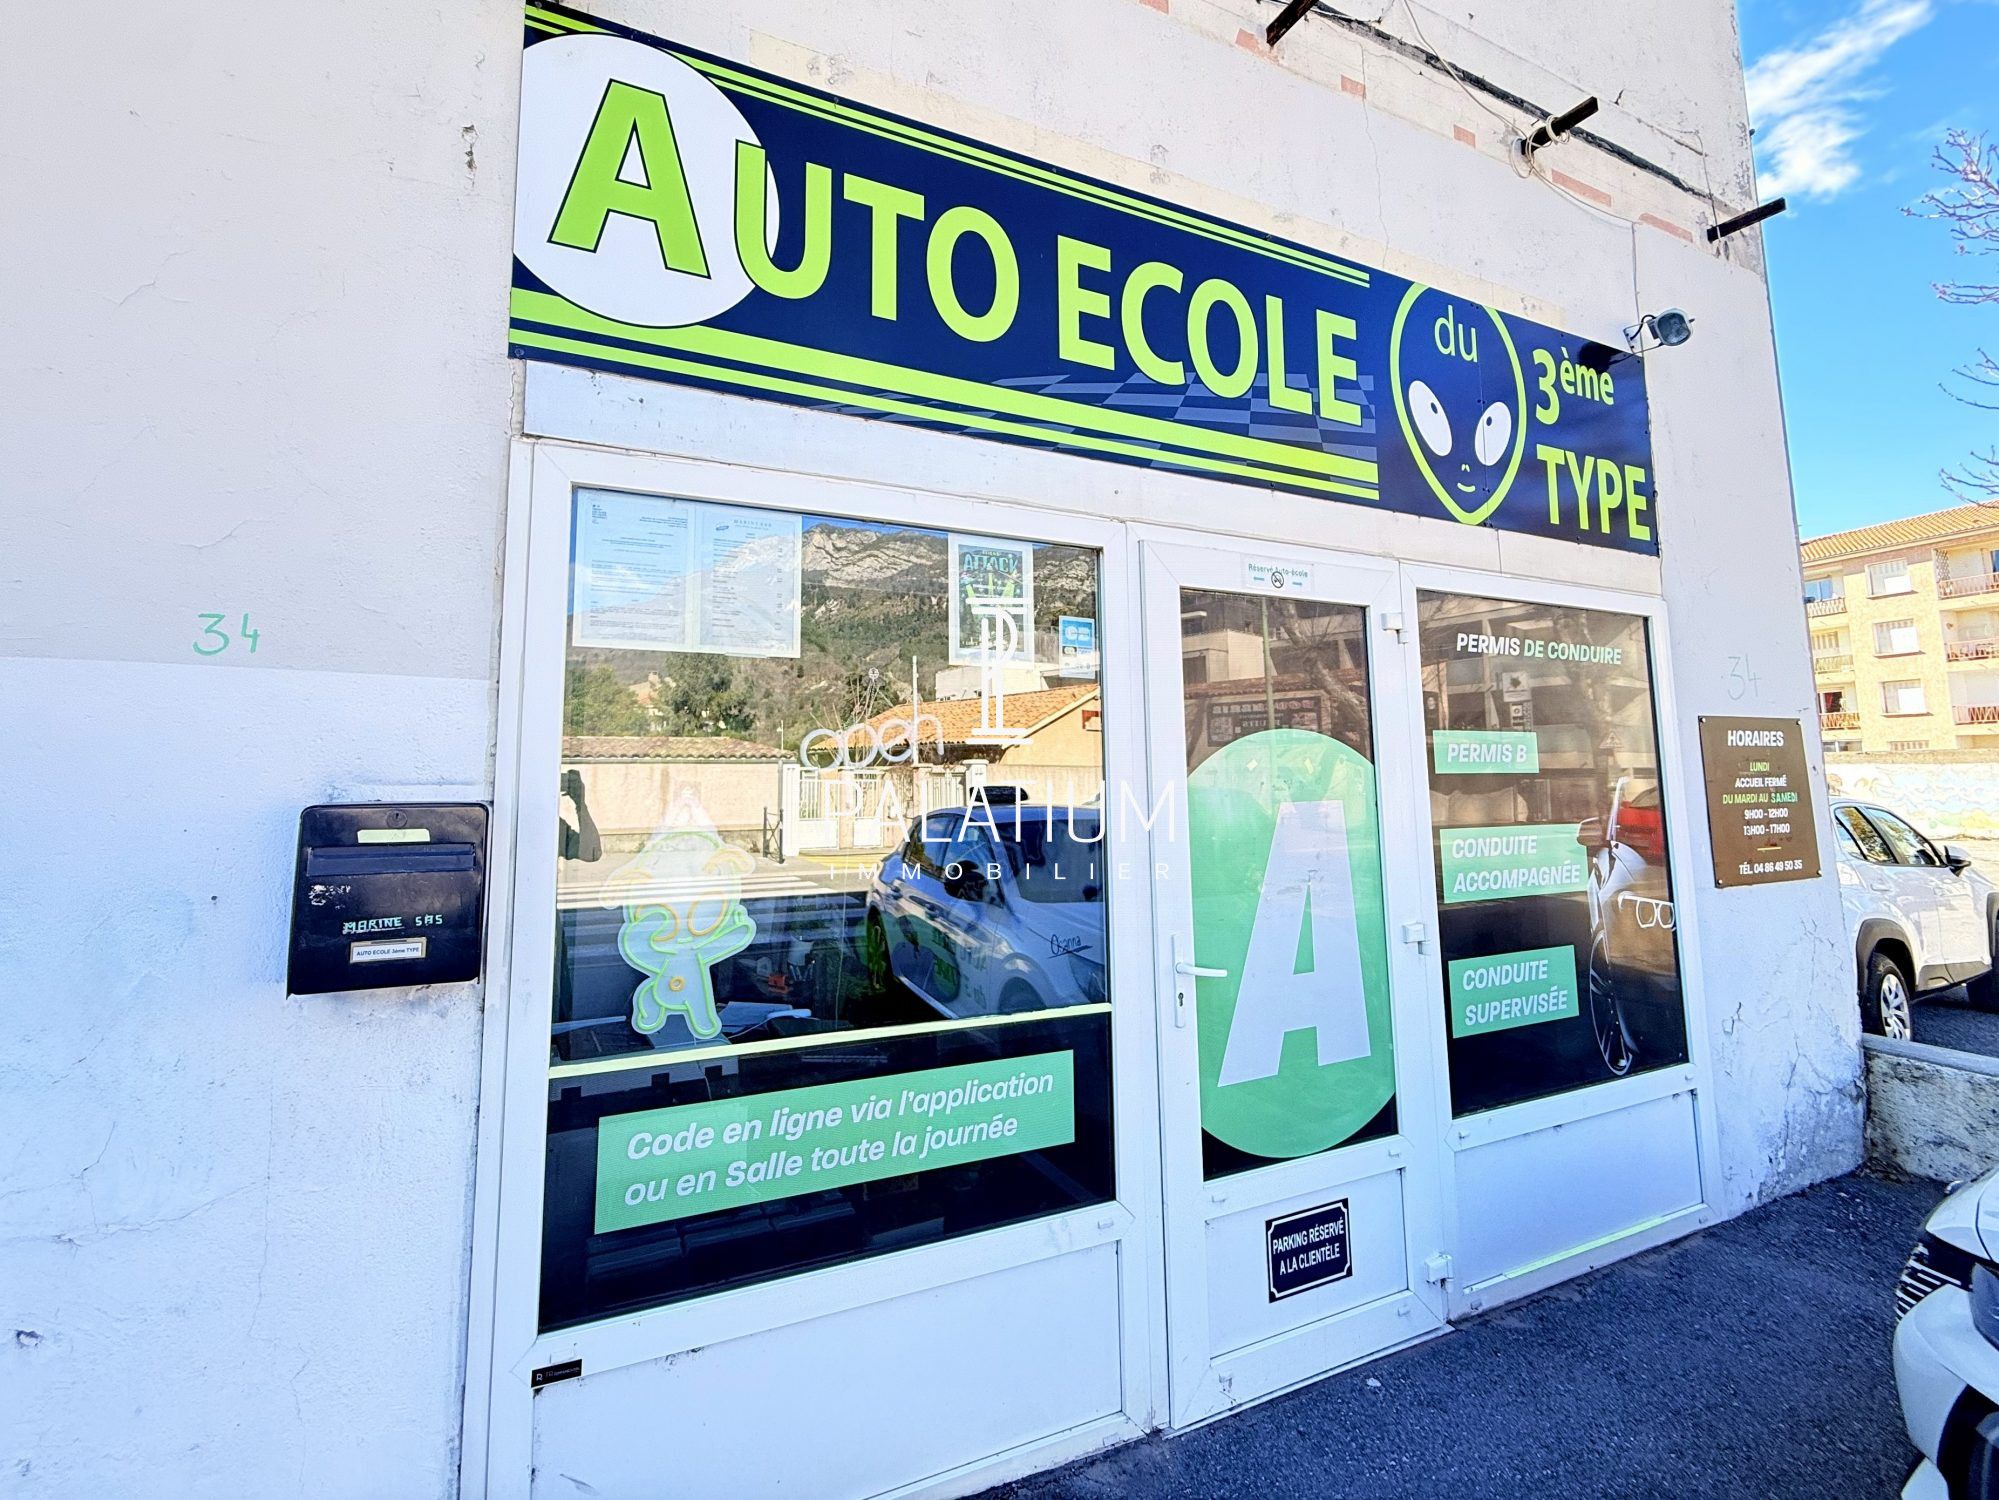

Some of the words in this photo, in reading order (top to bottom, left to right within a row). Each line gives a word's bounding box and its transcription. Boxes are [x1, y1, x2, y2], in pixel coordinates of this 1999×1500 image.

[546, 78, 1020, 343] AUTO
[1057, 234, 1363, 427] ECOLE
[1434, 304, 1478, 363] du
[1532, 346, 1614, 426] 3ème
[1536, 443, 1651, 542] TYPE
[192, 613, 260, 656] 34
[1456, 632, 1520, 655] PERMIS
[1524, 640, 1544, 658] DE
[1547, 643, 1623, 665] CONDUIRE
[1727, 653, 1761, 700] 34
[1447, 743, 1512, 763] PERMIS
[1516, 745, 1528, 763] B
[1727, 730, 1784, 747] HORAIRES
[1735, 777, 1764, 788] ACCUEIL
[1764, 775, 1787, 787] FERMÉ
[1750, 762, 1770, 772] LUNDI
[1723, 794, 1733, 804] DU
[1735, 793, 1757, 804] MARDI
[1759, 793, 1768, 803] AU
[1770, 791, 1798, 804] SAMEDI
[1744, 808, 1763, 820] 9H00
[1768, 808, 1788, 819] 12H00
[1743, 824, 1765, 836] 13H00
[1770, 823, 1790, 834] 17H00
[1452, 835, 1537, 859] CONDUITE
[1453, 860, 1580, 894] ACCOMPAGNÉE
[1754, 864, 1763, 874] 04
[343, 917, 403, 933] MARINE
[415, 914, 443, 926] SAS
[1217, 800, 1371, 1088] A
[1463, 959, 1548, 990] CONDUITE
[1465, 986, 1568, 1026] SUPERVISÉE
[627, 1121, 713, 1161] Code
[722, 1119, 762, 1145] en
[770, 1107, 842, 1142] ligne
[850, 1095, 893, 1124] via
[898, 1071, 1054, 1118] l'application
[624, 1178, 665, 1206] ou
[676, 1170, 715, 1196] en
[725, 1150, 802, 1188] Salle
[811, 1138, 885, 1171] toute
[892, 1131, 916, 1158] la
[918, 1114, 1018, 1160] journée
[1272, 1230, 1307, 1255] PARKING
[1309, 1216, 1344, 1243] RÉSERVÉ
[1280, 1259, 1286, 1275] A
[1287, 1256, 1298, 1273] LA
[1298, 1242, 1340, 1269] CLIENTÈLE
